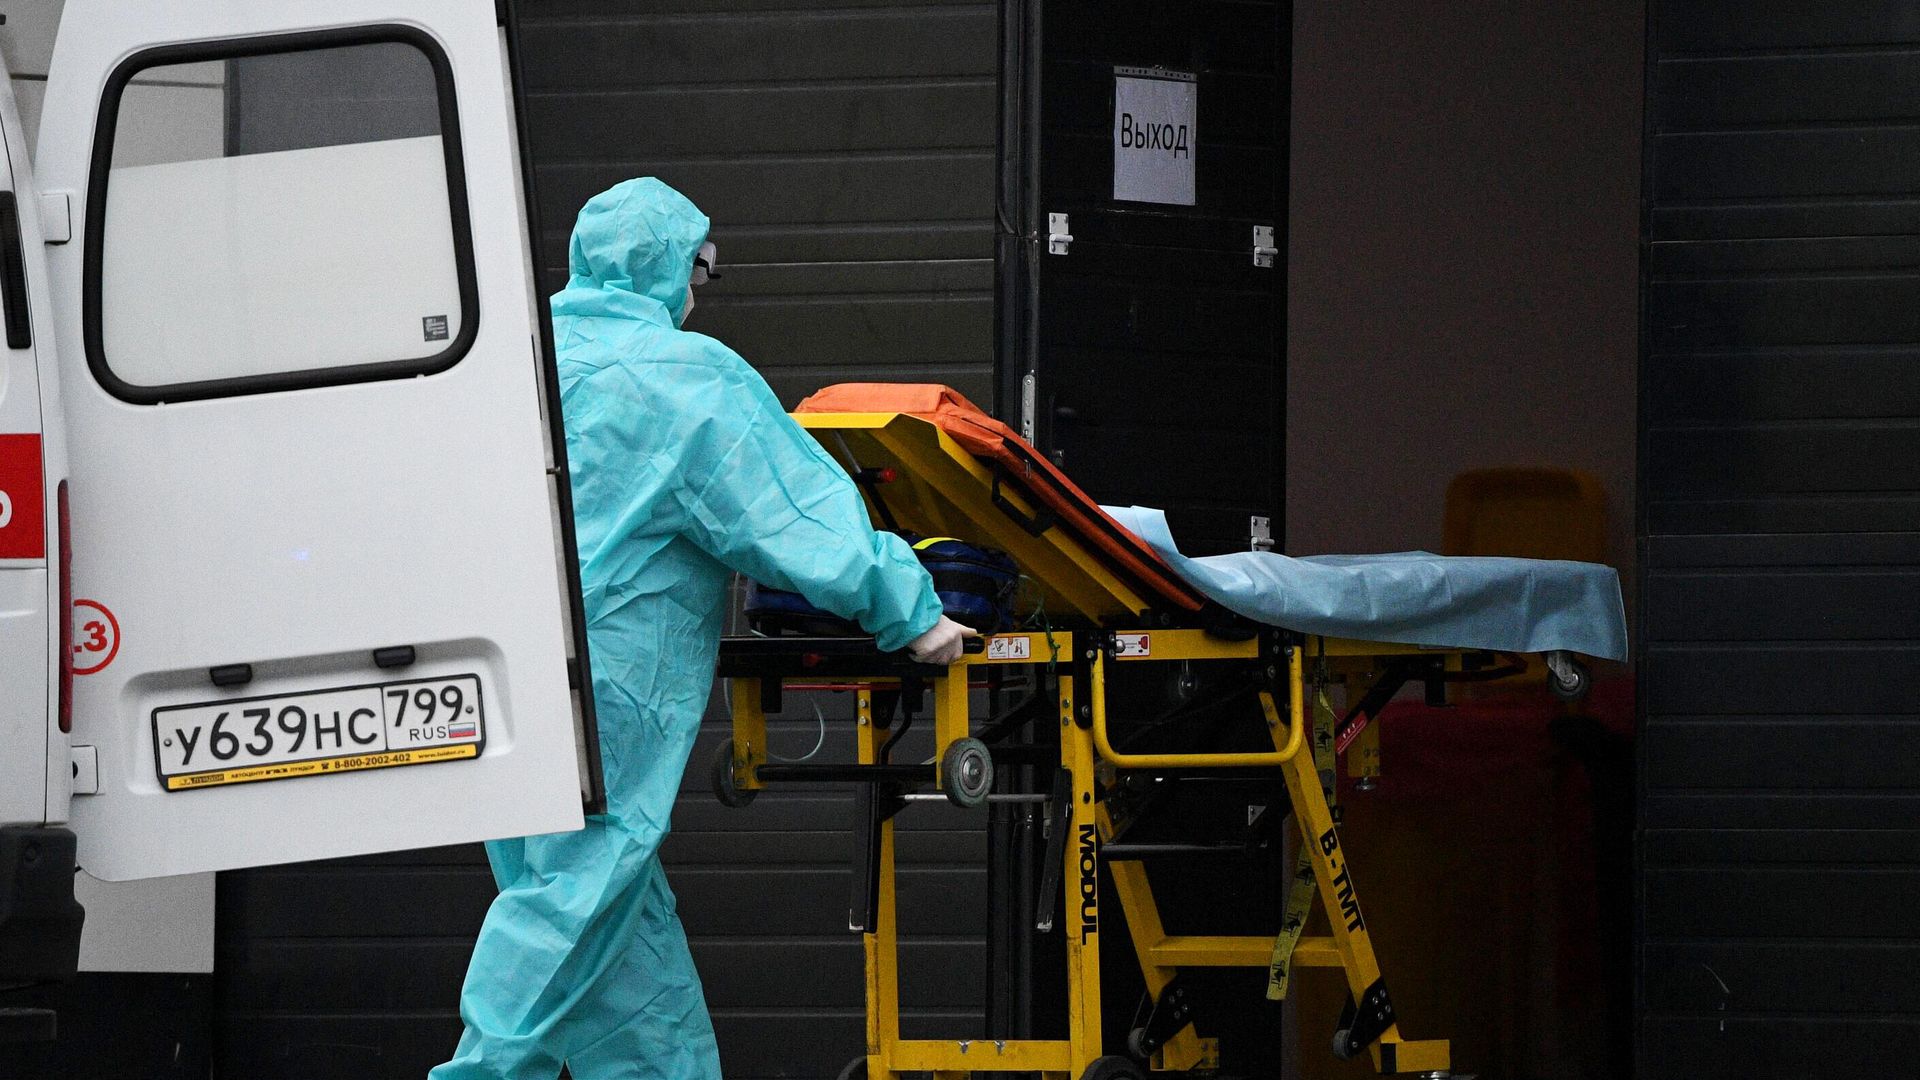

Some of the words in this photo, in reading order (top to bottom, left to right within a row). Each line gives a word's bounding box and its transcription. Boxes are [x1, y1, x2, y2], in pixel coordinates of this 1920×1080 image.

[1121, 112, 1189, 160] Выход
[74, 621, 108, 653] .3
[175, 704, 378, 766] У639НС
[386, 685, 464, 728] 799
[409, 726, 447, 742] RUS
[334, 753, 411, 769] 8-800-2002-402
[1079, 823, 1097, 946] MODUL
